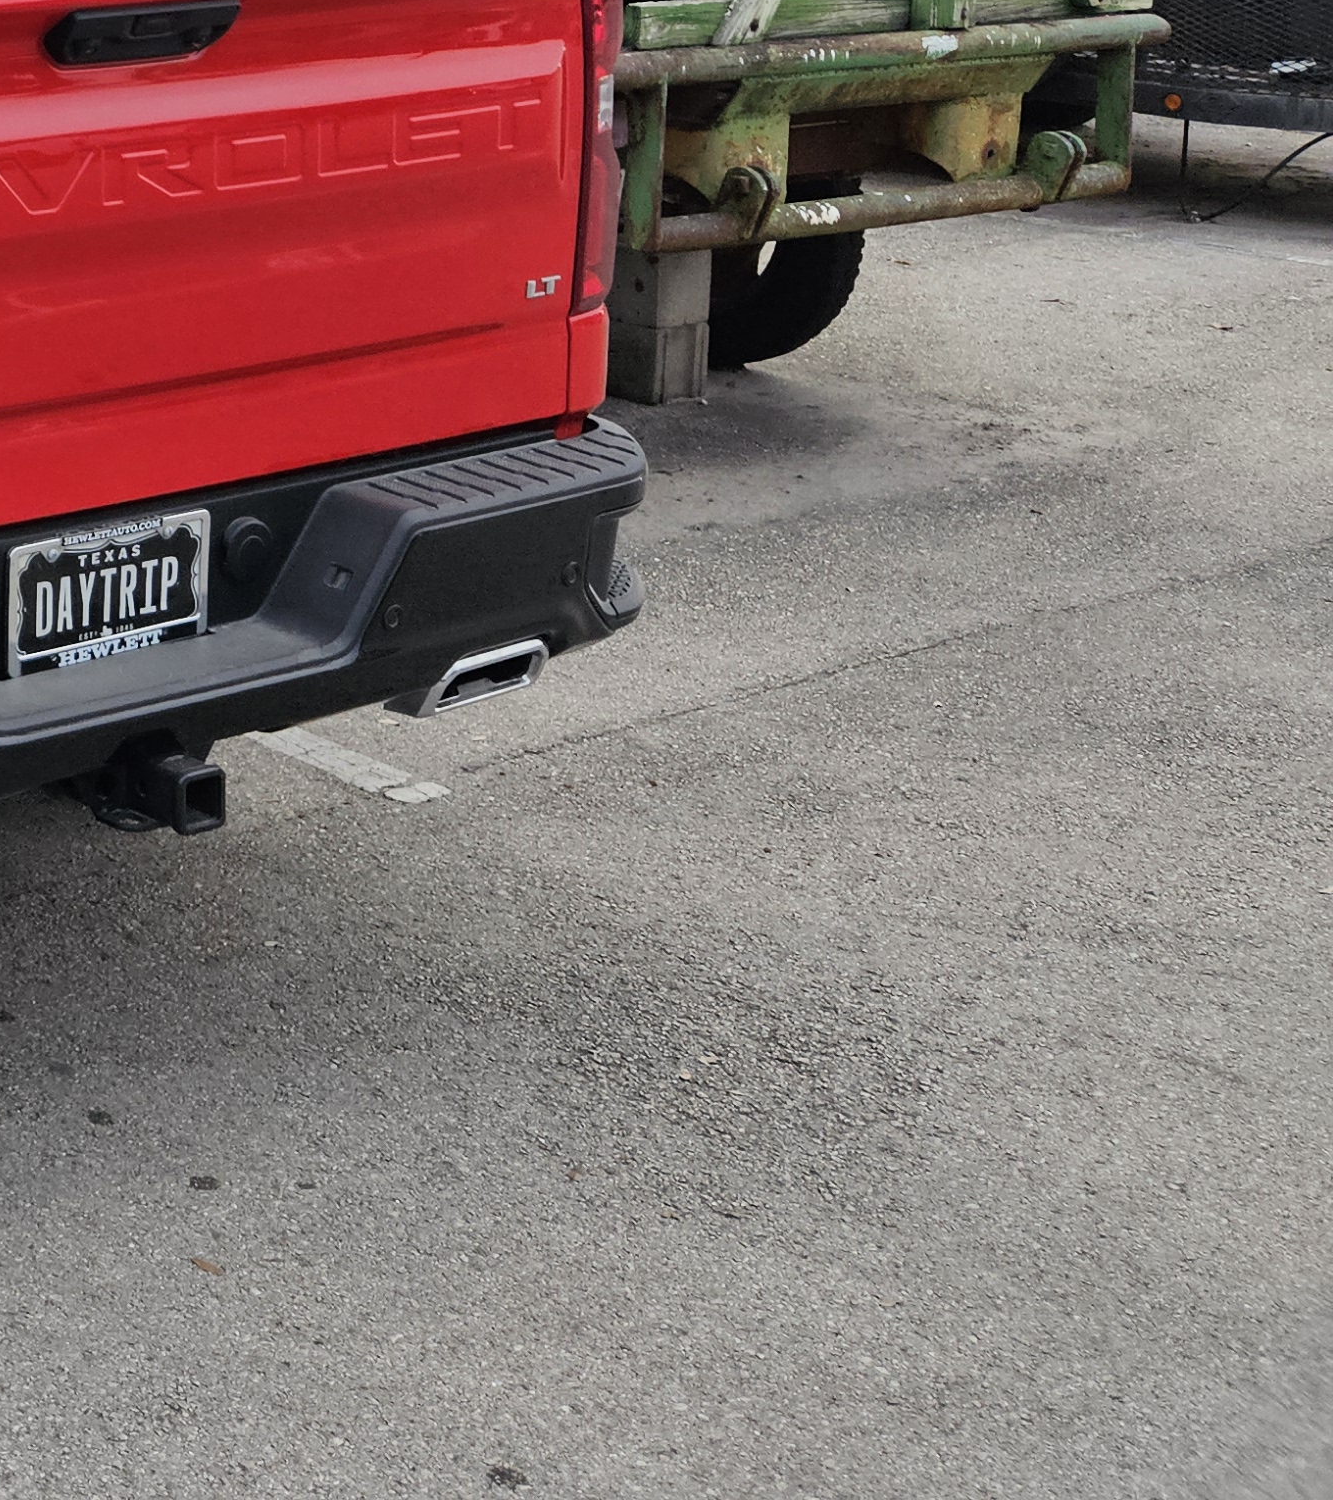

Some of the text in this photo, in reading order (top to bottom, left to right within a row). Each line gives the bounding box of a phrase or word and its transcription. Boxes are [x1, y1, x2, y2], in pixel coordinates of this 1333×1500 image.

[524, 274, 561, 301] LT
[77, 544, 141, 568] TEXAS
[35, 555, 180, 638] DAYTRIP
[57, 629, 163, 669] HEWLETT
